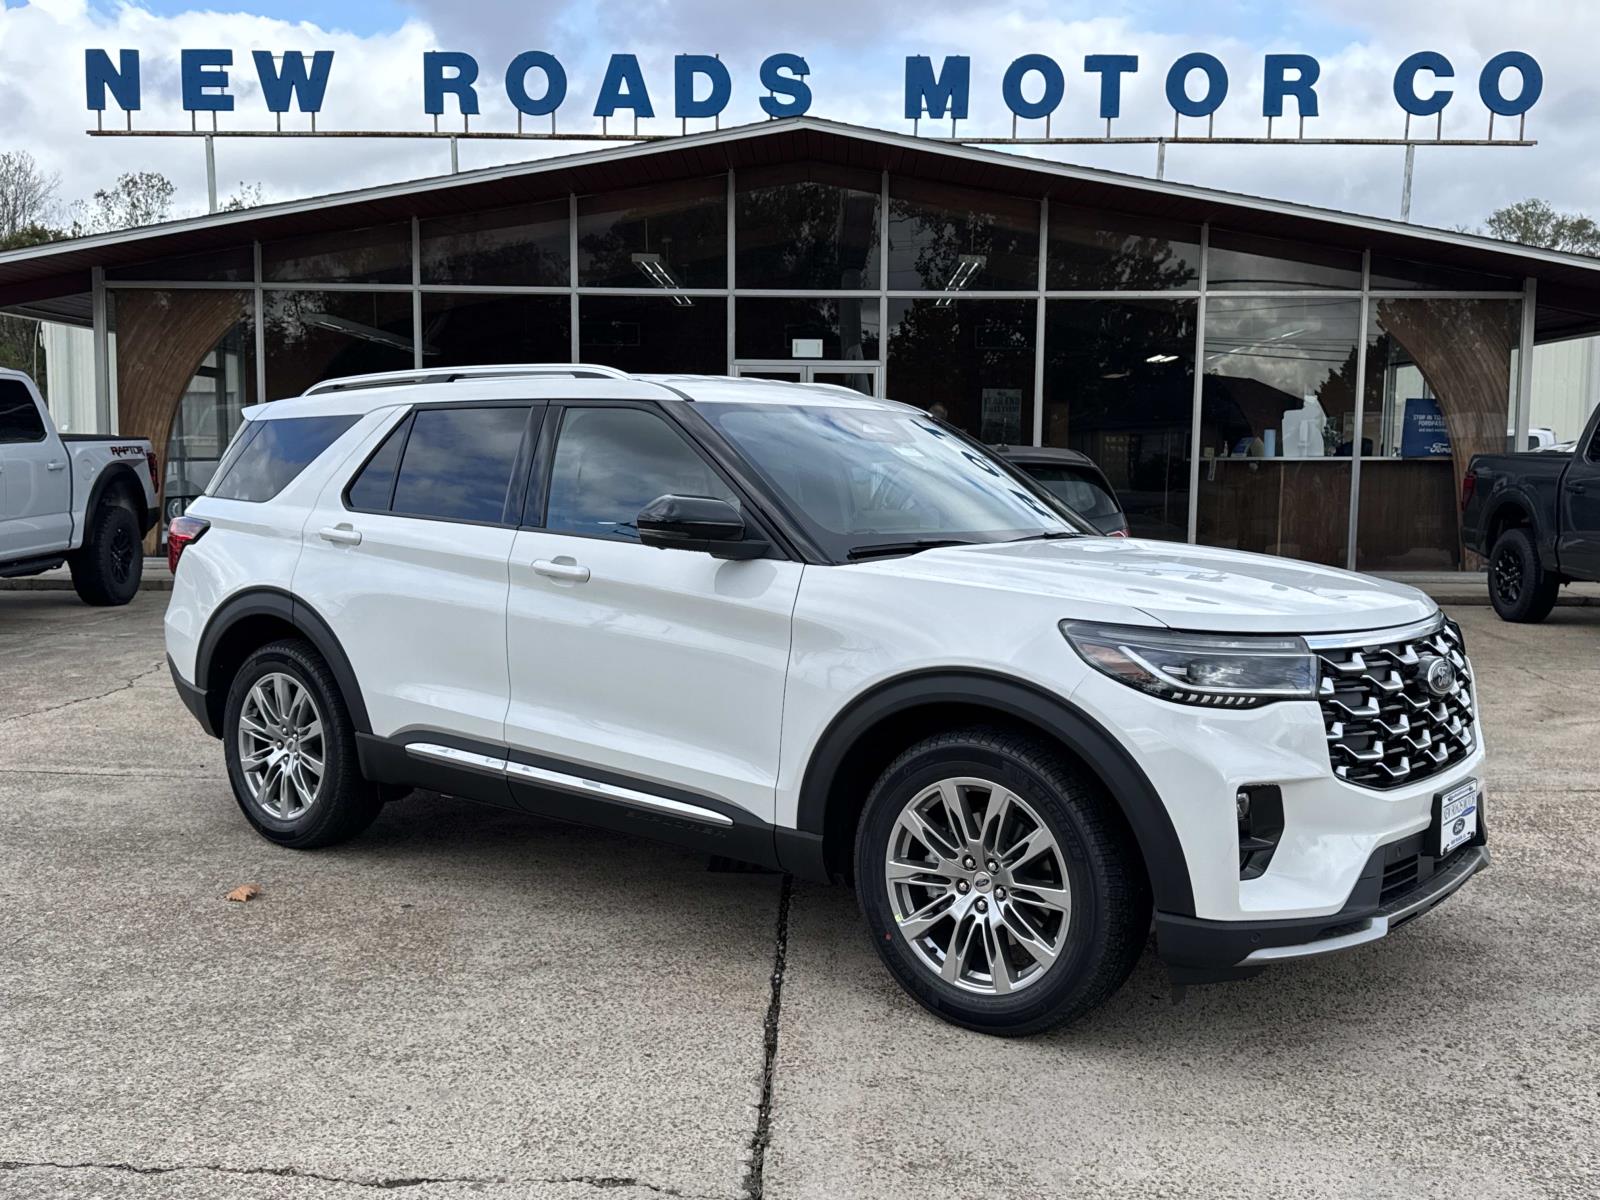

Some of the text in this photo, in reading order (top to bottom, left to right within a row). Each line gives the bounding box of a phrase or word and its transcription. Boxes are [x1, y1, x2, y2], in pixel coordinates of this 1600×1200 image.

[86, 49, 1543, 119] NEW ROADS MOTOR CO
[110, 446, 146, 458] RAPTOR
